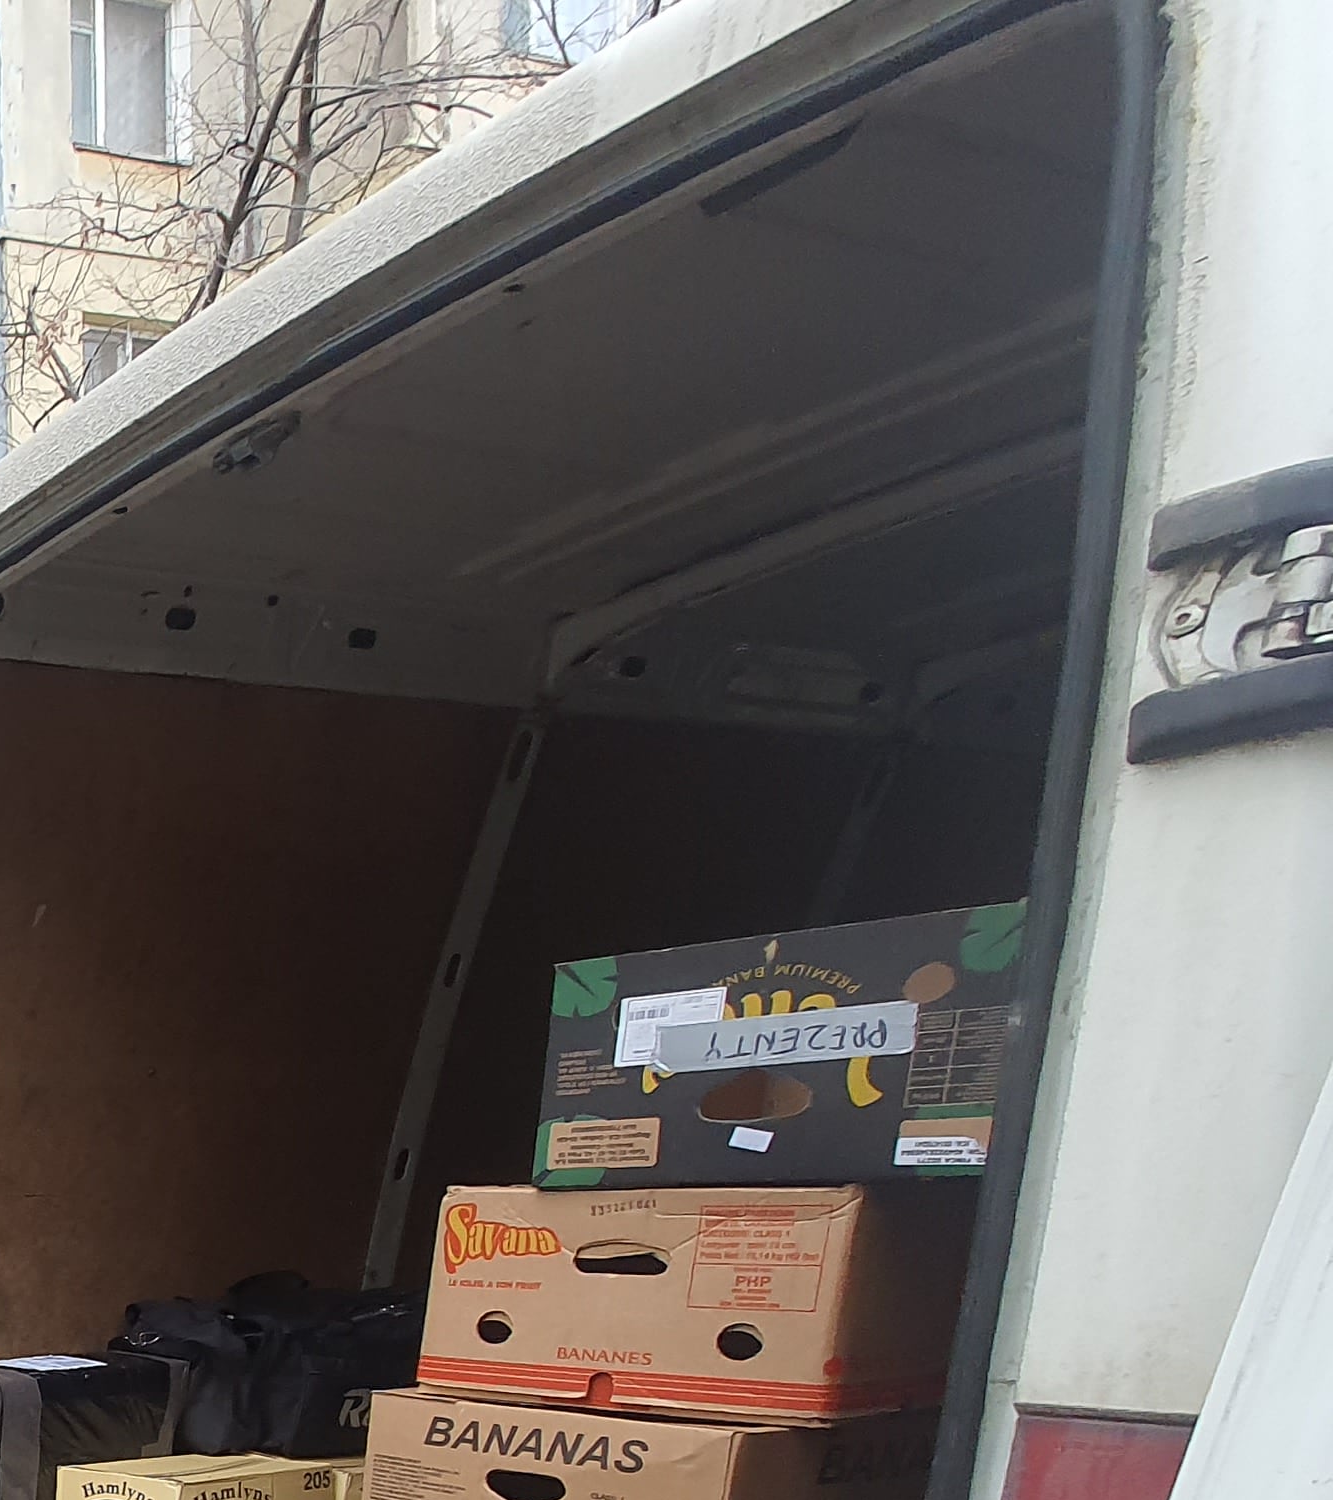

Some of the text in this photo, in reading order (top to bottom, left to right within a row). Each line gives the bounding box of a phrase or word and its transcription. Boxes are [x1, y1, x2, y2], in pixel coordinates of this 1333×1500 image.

[775, 964, 862, 994] PREMIUM
[445, 1203, 562, 1274] Savana
[557, 1347, 652, 1366] BANANES
[424, 1416, 649, 1473] BANANAS
[303, 1470, 331, 1491] 205
